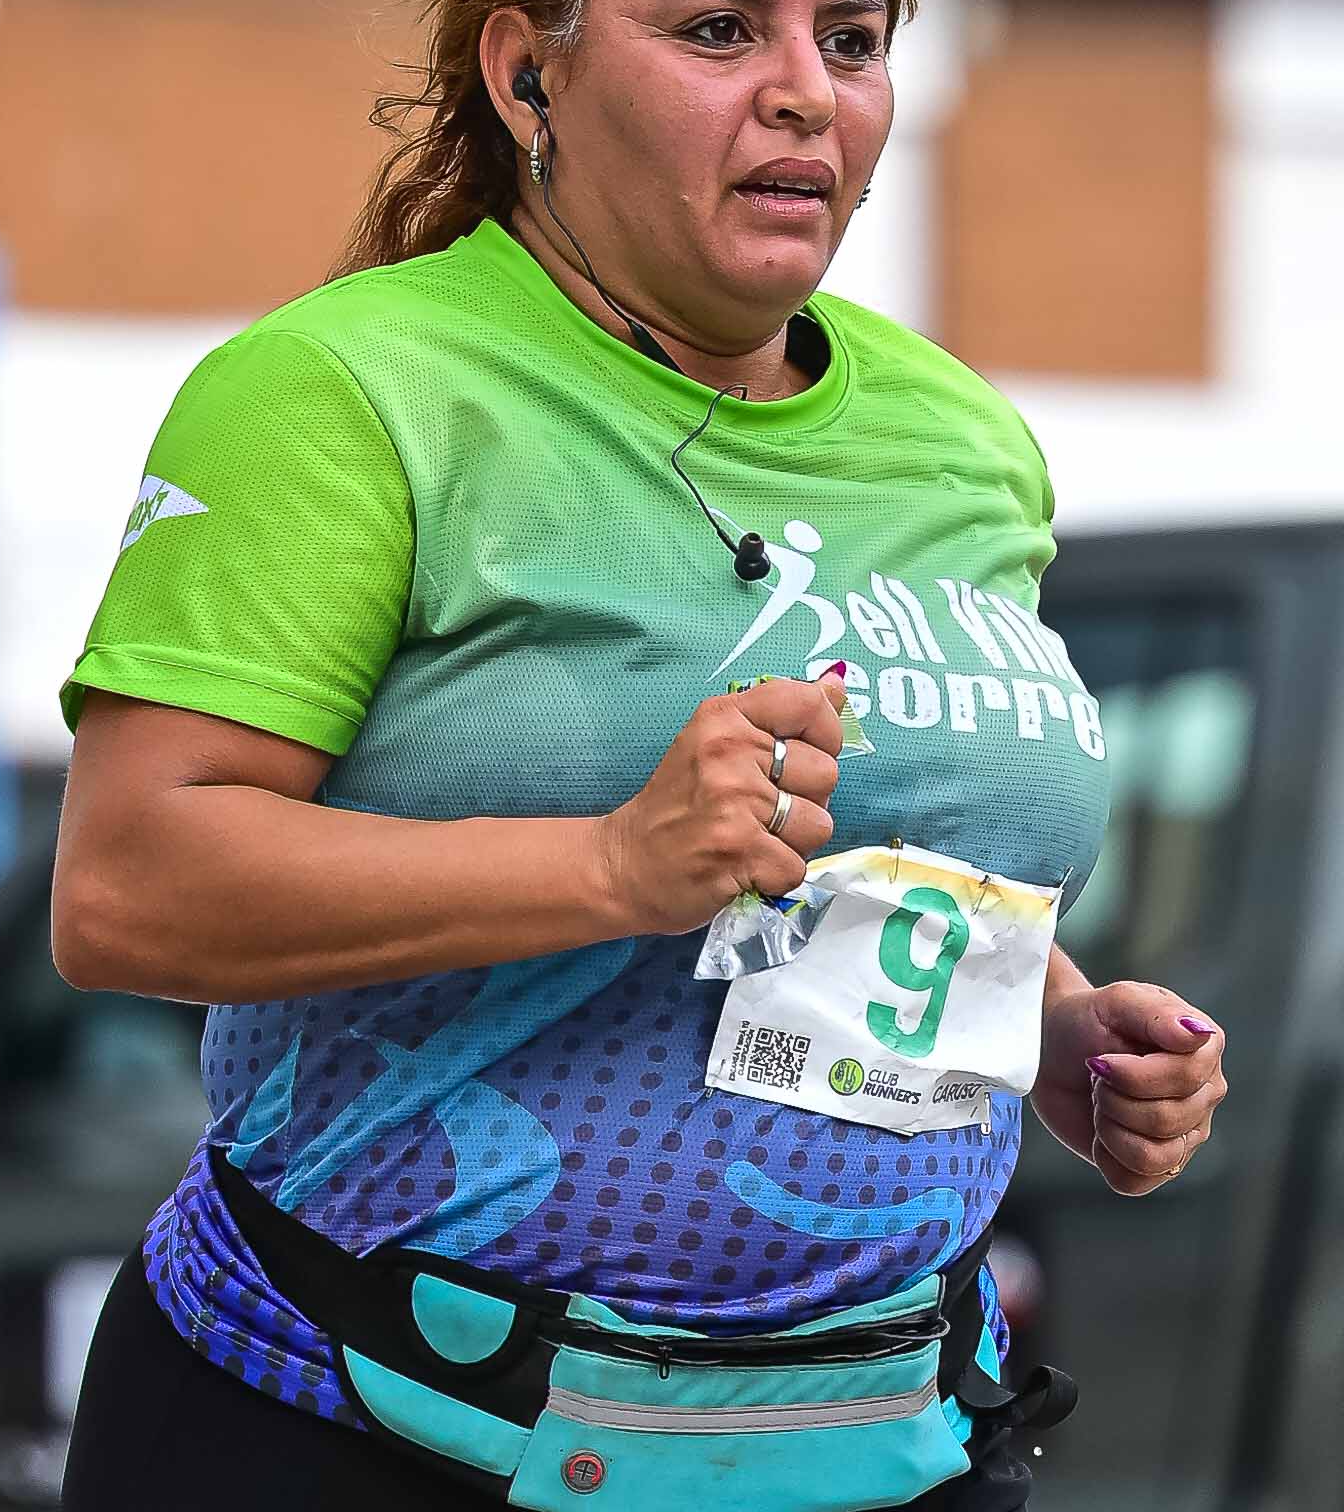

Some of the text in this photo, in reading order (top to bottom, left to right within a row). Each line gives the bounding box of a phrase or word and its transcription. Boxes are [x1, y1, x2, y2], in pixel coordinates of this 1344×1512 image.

[866, 887, 969, 1059] 9
[868, 1069, 899, 1086] CLUB
[862, 1082, 922, 1104] RUNNER'S
